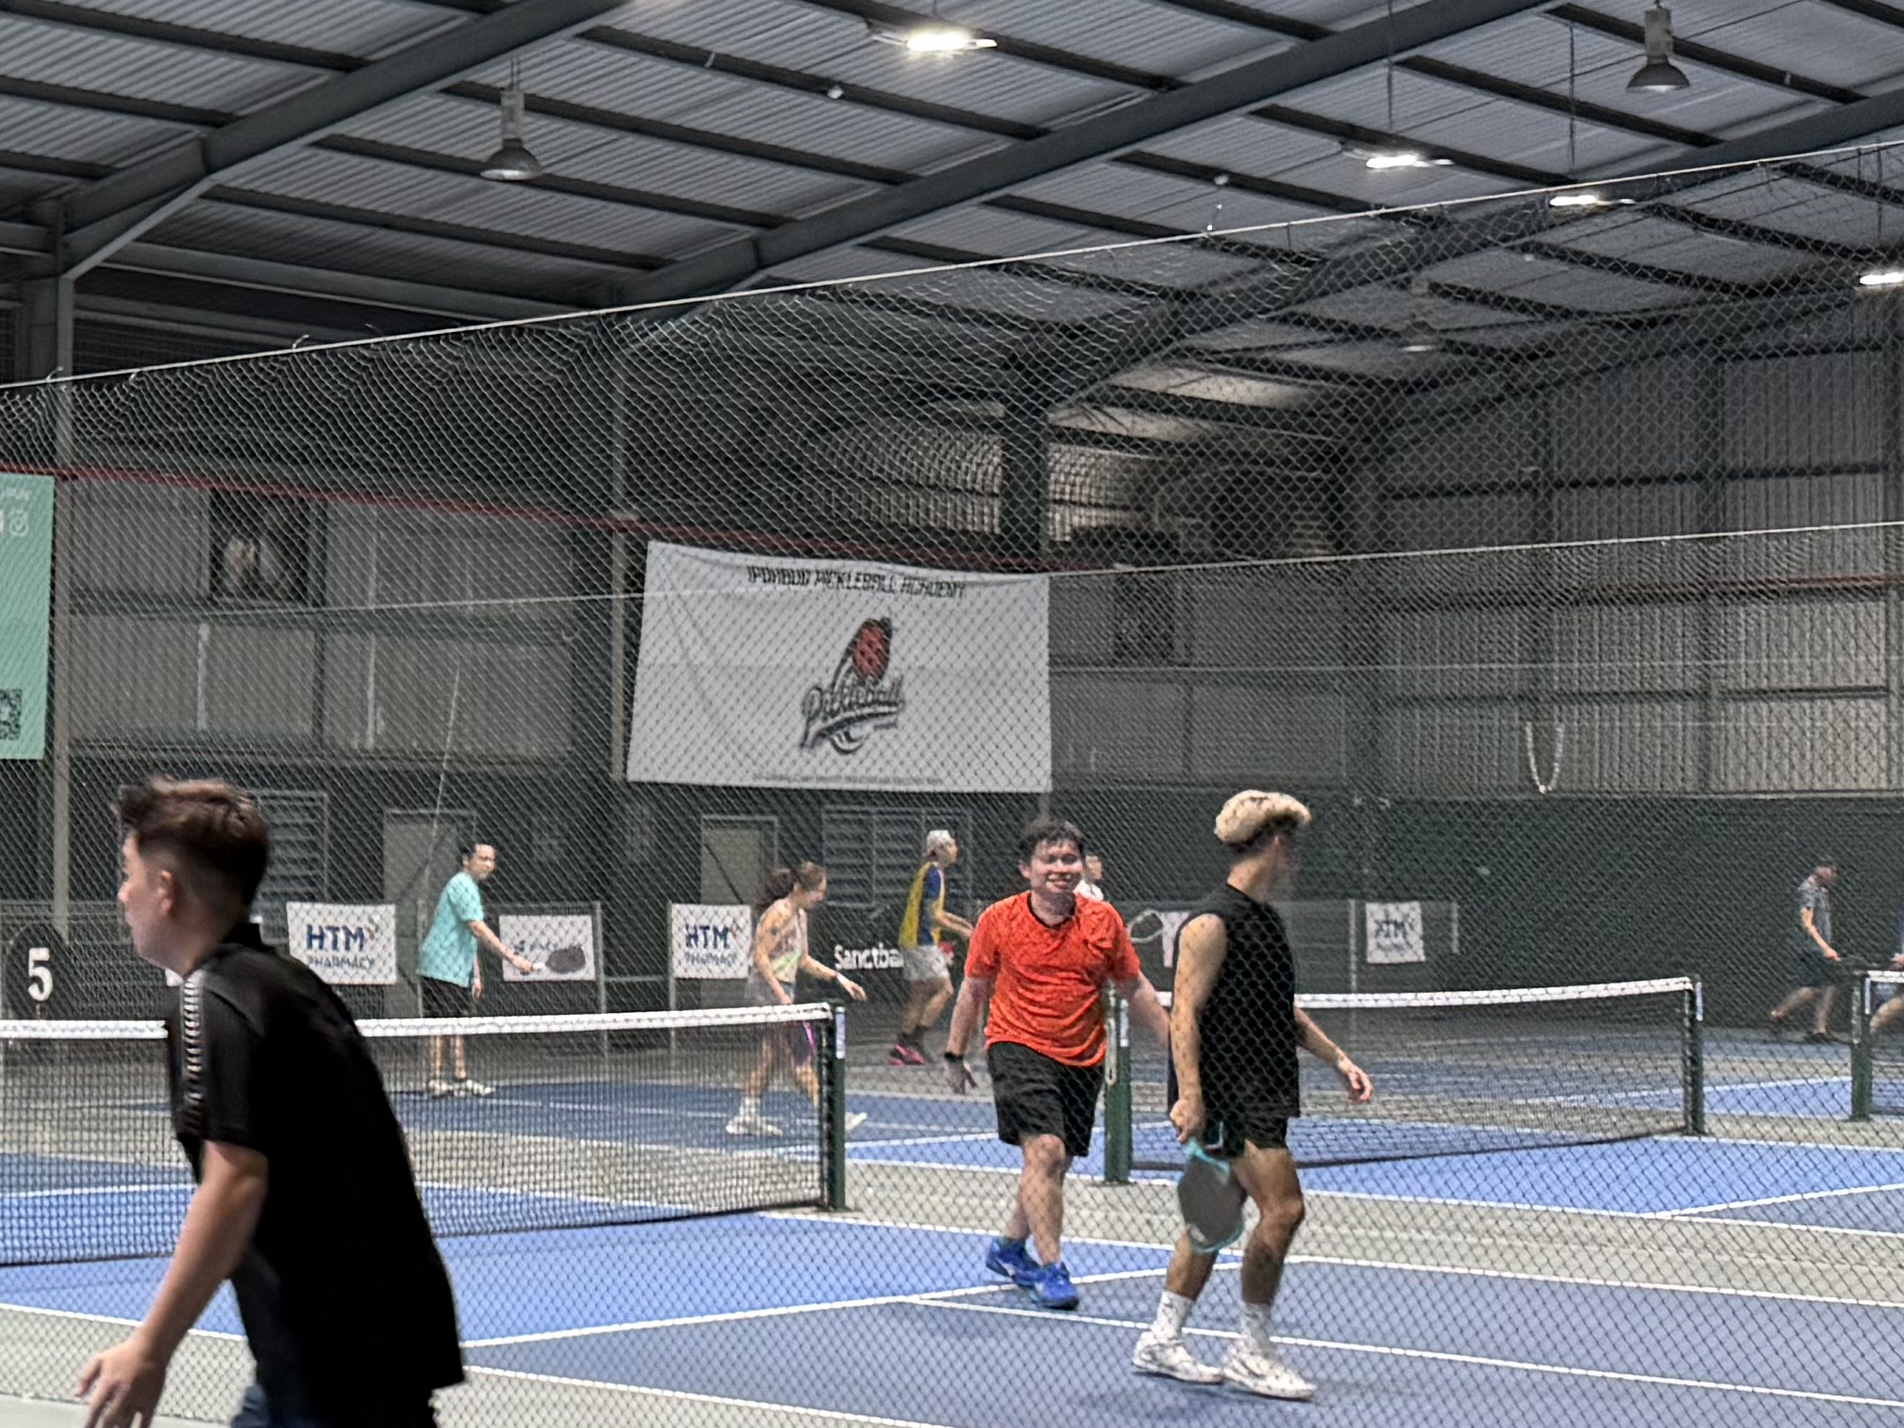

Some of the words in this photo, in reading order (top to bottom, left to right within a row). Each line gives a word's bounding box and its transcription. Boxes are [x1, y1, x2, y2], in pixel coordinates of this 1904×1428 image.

[306, 924, 364, 951] HTM
[685, 924, 730, 949] HTM
[834, 942, 904, 970] Sanctba
[26, 947, 54, 1002] 5
